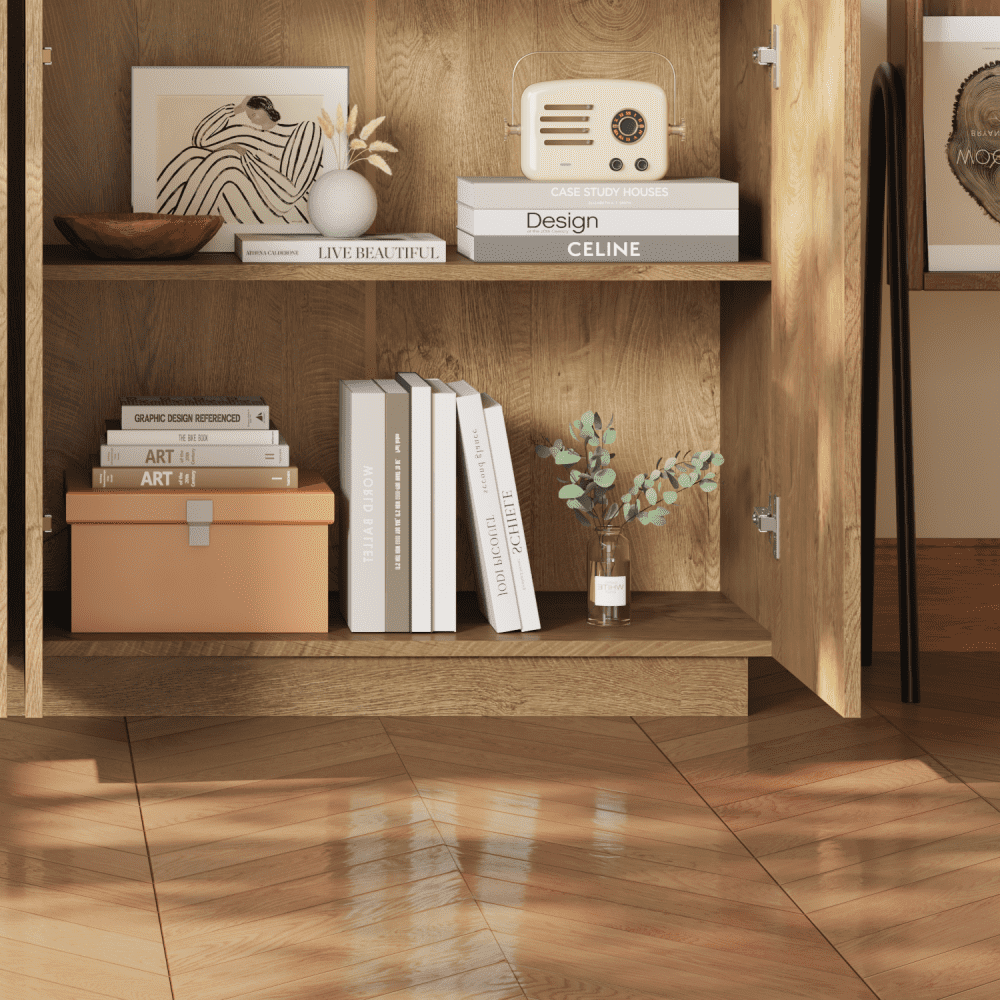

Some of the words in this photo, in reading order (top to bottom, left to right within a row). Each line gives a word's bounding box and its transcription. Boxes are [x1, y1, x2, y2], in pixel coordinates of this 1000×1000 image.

[551, 187, 580, 196] CASE
[584, 187, 620, 196] STUDY
[624, 187, 668, 196] HOUSES
[527, 212, 598, 233] Design
[319, 247, 352, 259] LIVE
[356, 247, 439, 259] BEAUTIFUL
[568, 242, 640, 256] CELINE
[134, 414, 165, 423] GRAPHIC
[168, 414, 193, 422] DESIGN
[195, 414, 240, 422] REFERENCED
[145, 449, 174, 463] ART
[140, 471, 173, 486] ART
